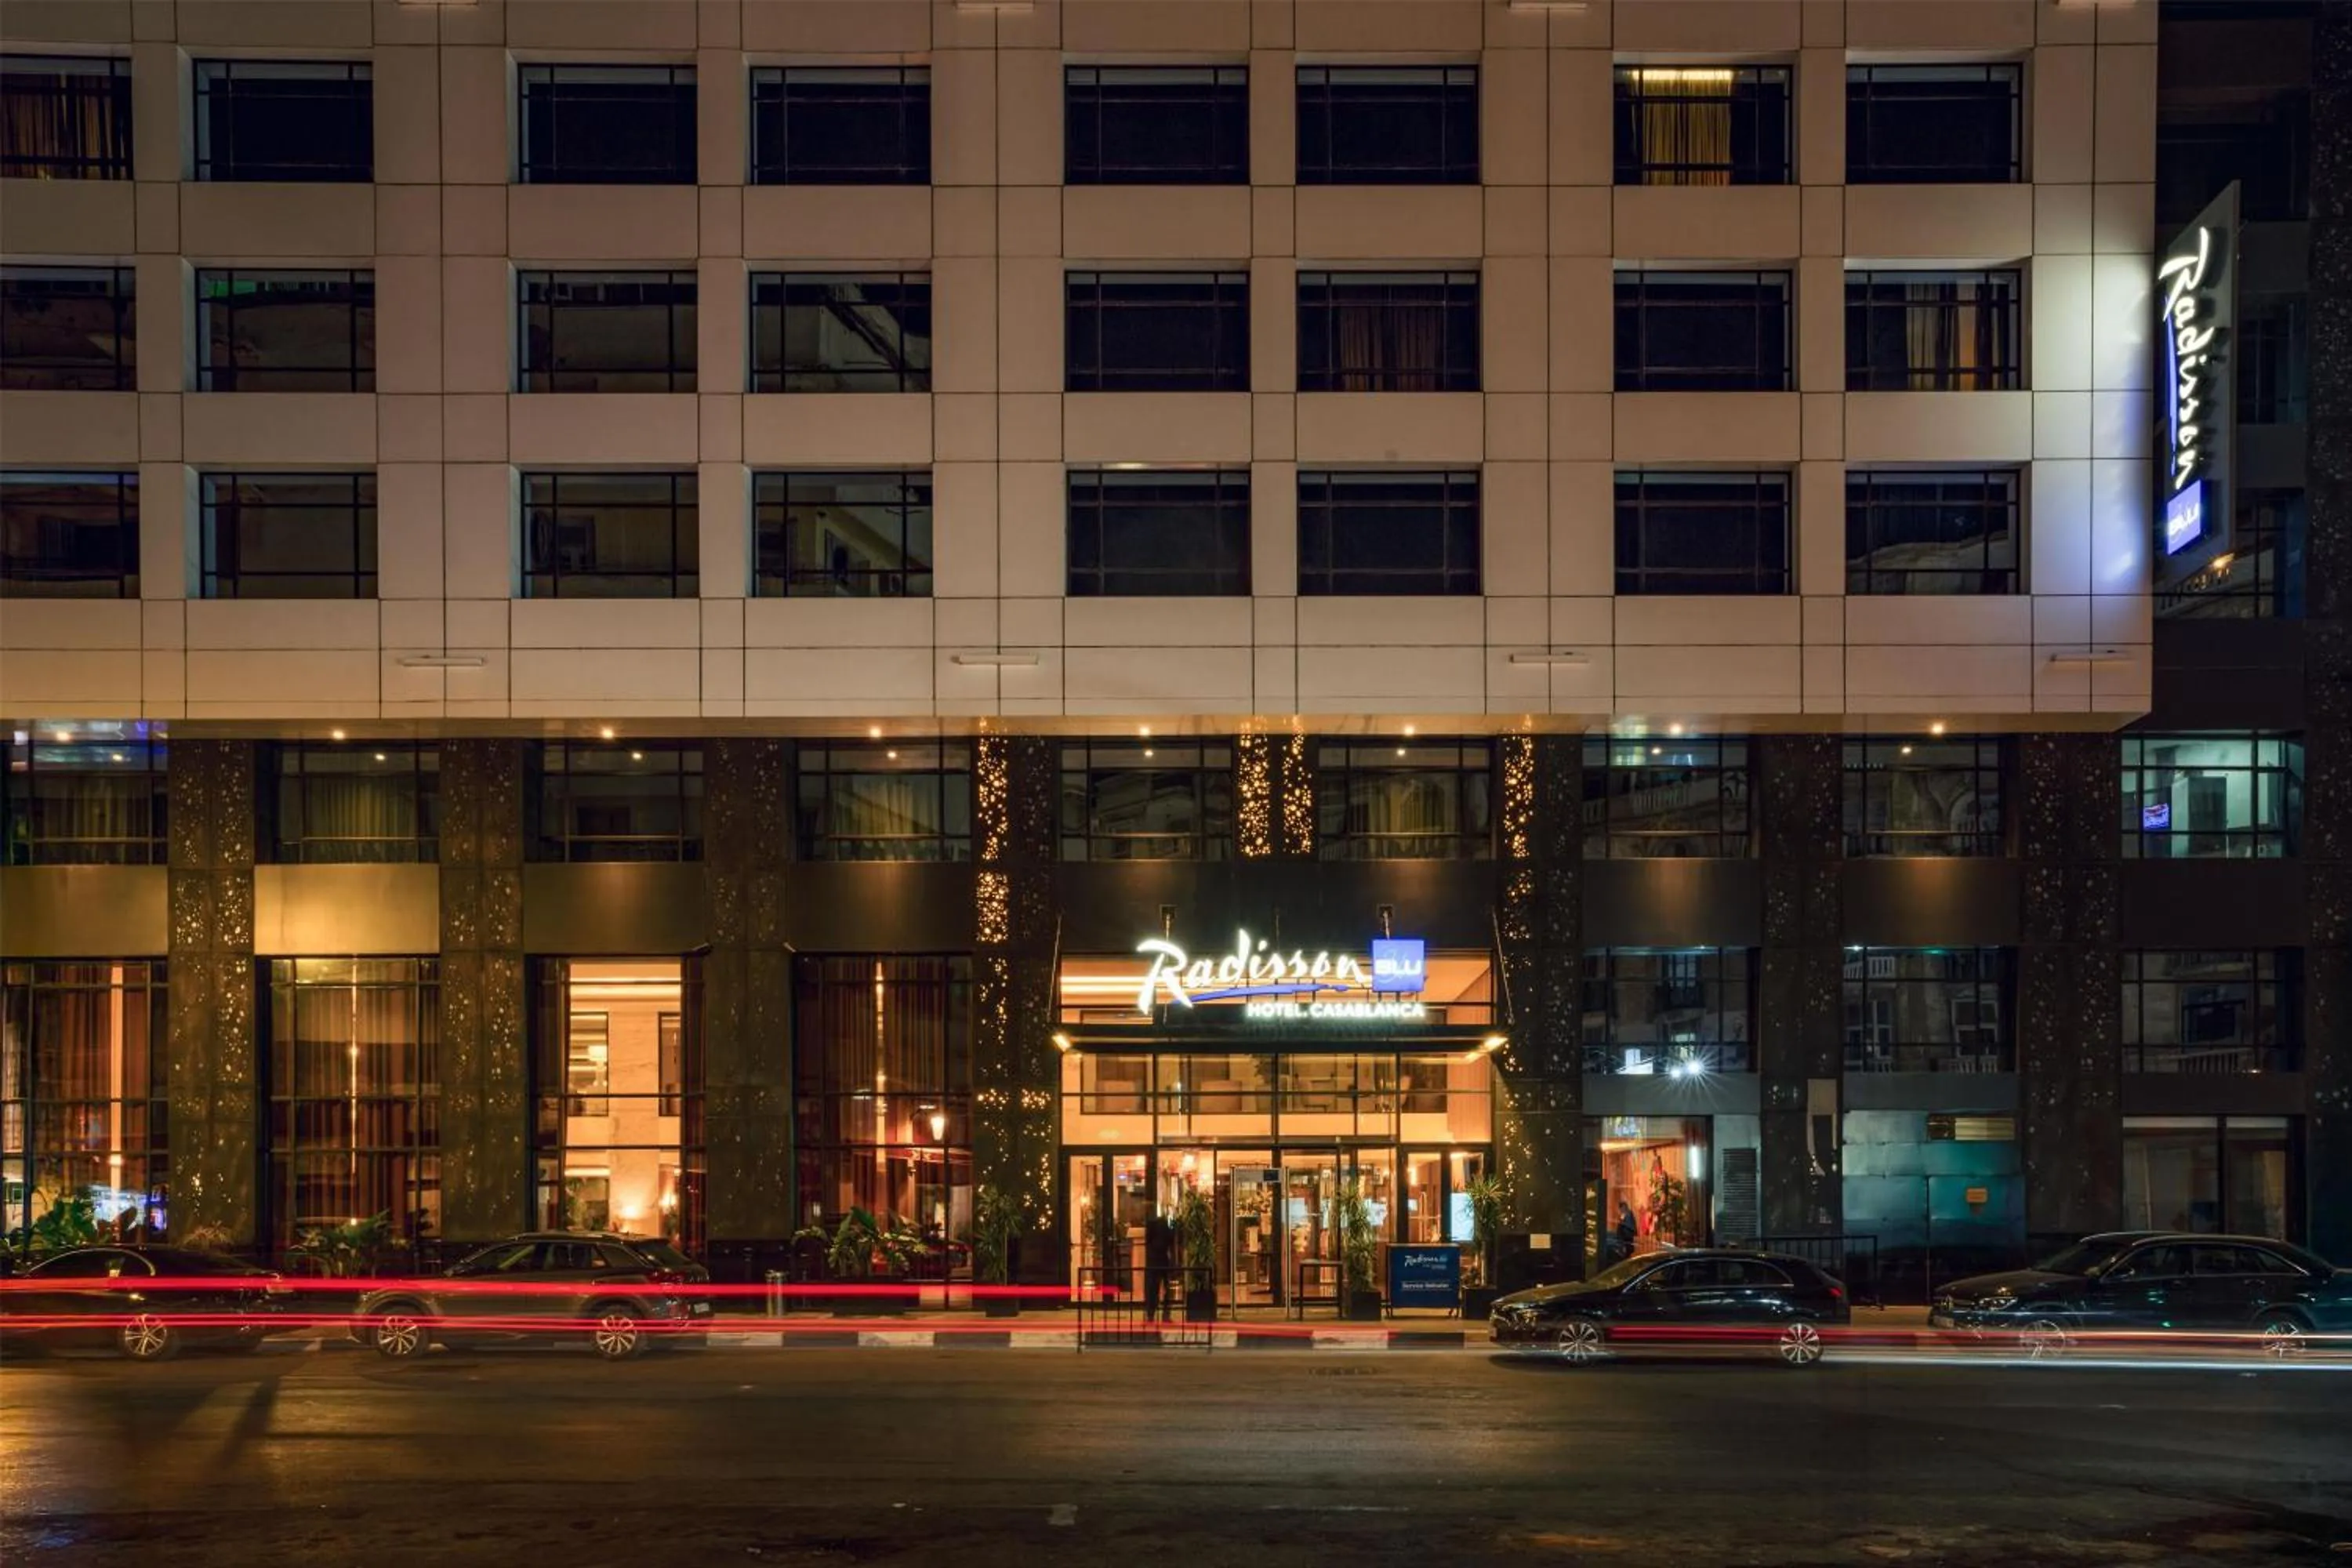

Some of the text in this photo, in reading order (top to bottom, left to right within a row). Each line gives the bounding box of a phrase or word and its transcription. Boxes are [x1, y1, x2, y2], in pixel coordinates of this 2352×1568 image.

[2158, 227, 2215, 490] Radisson
[1136, 927, 1422, 1014] Radisson BLU
[1309, 1002, 1425, 1019] CASABLANCA
